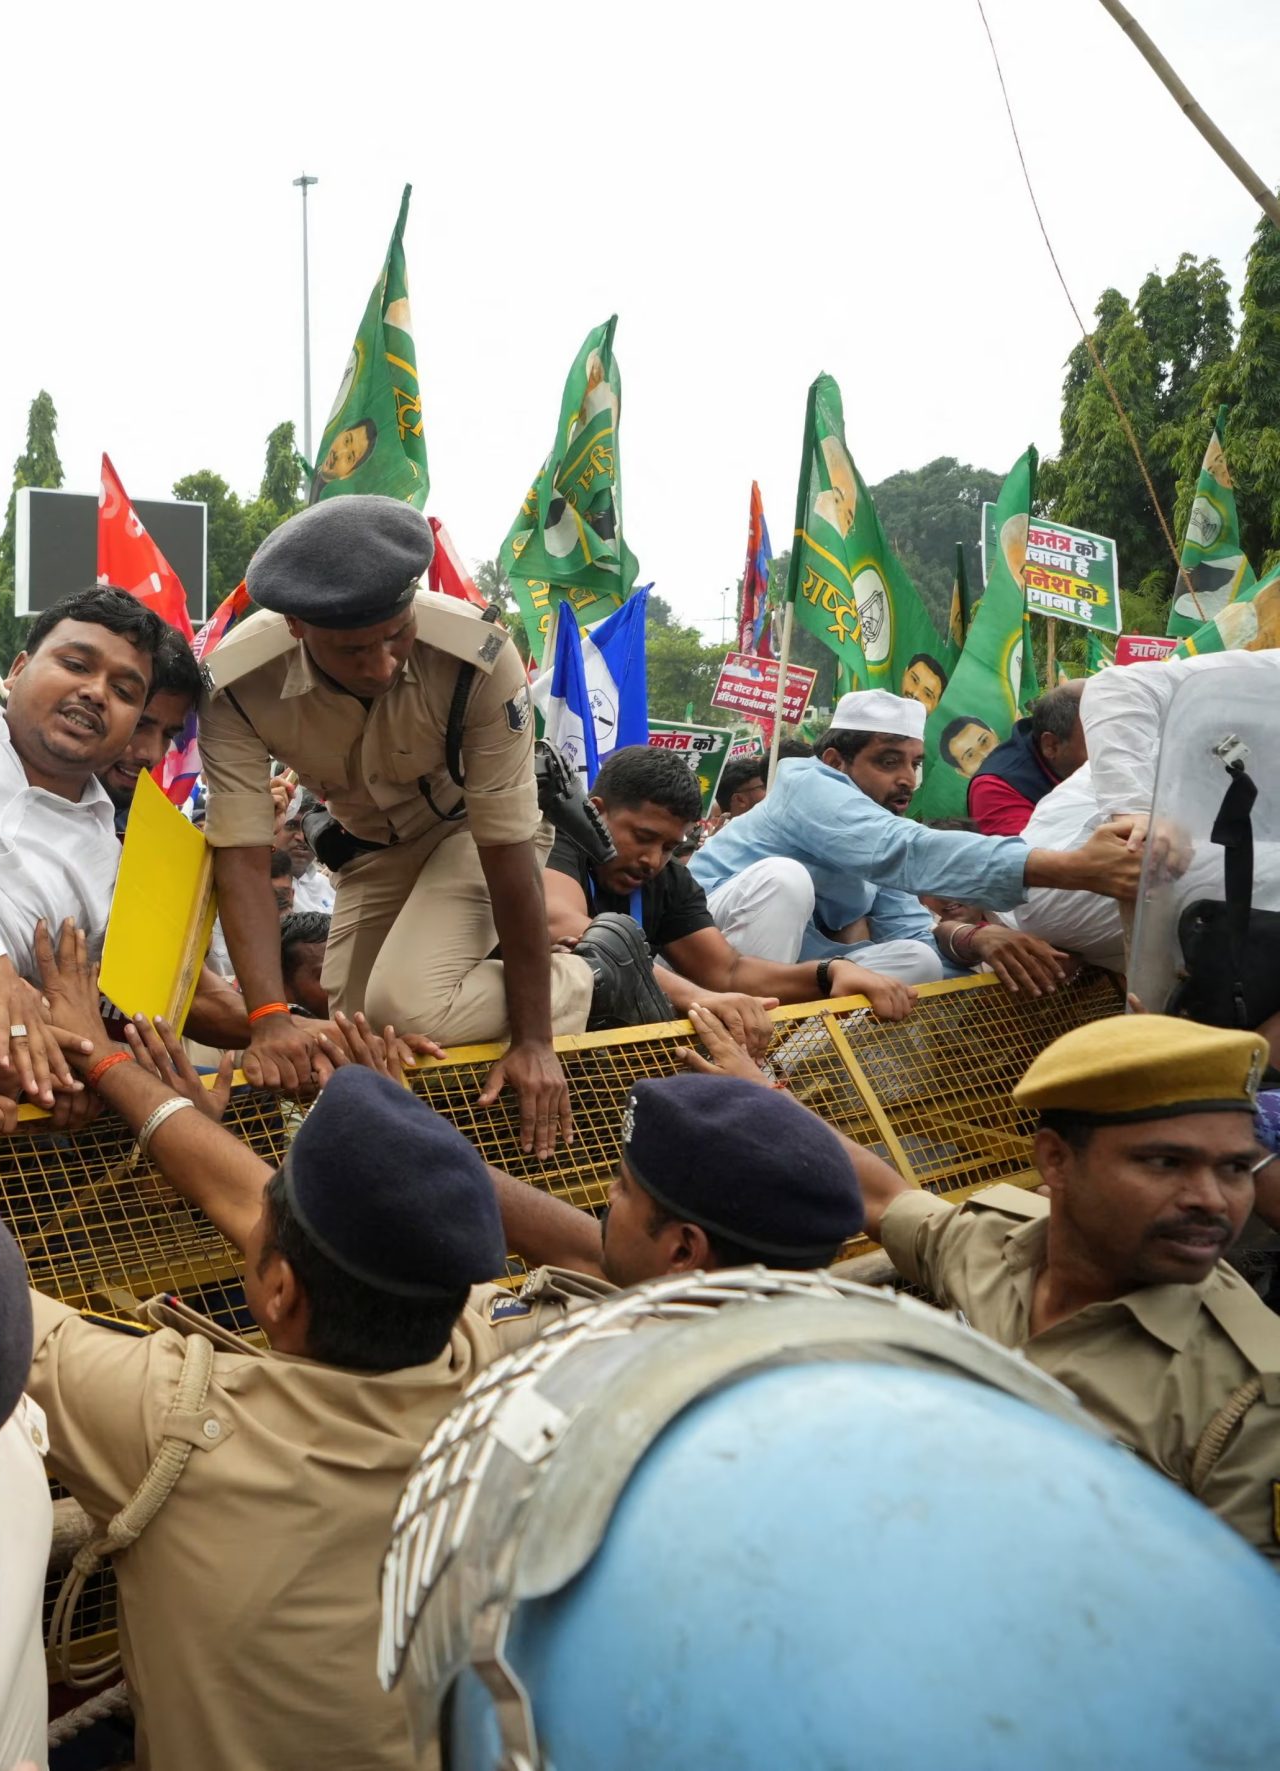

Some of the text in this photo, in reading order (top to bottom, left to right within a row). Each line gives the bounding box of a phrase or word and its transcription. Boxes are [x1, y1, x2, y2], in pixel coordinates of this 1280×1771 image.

[1028, 529, 1098, 558] कतंत्र को
[1075, 556, 1089, 578] है
[1075, 584, 1098, 602] को
[1078, 600, 1093, 621] है
[649, 731, 716, 751] कतंत्र को
